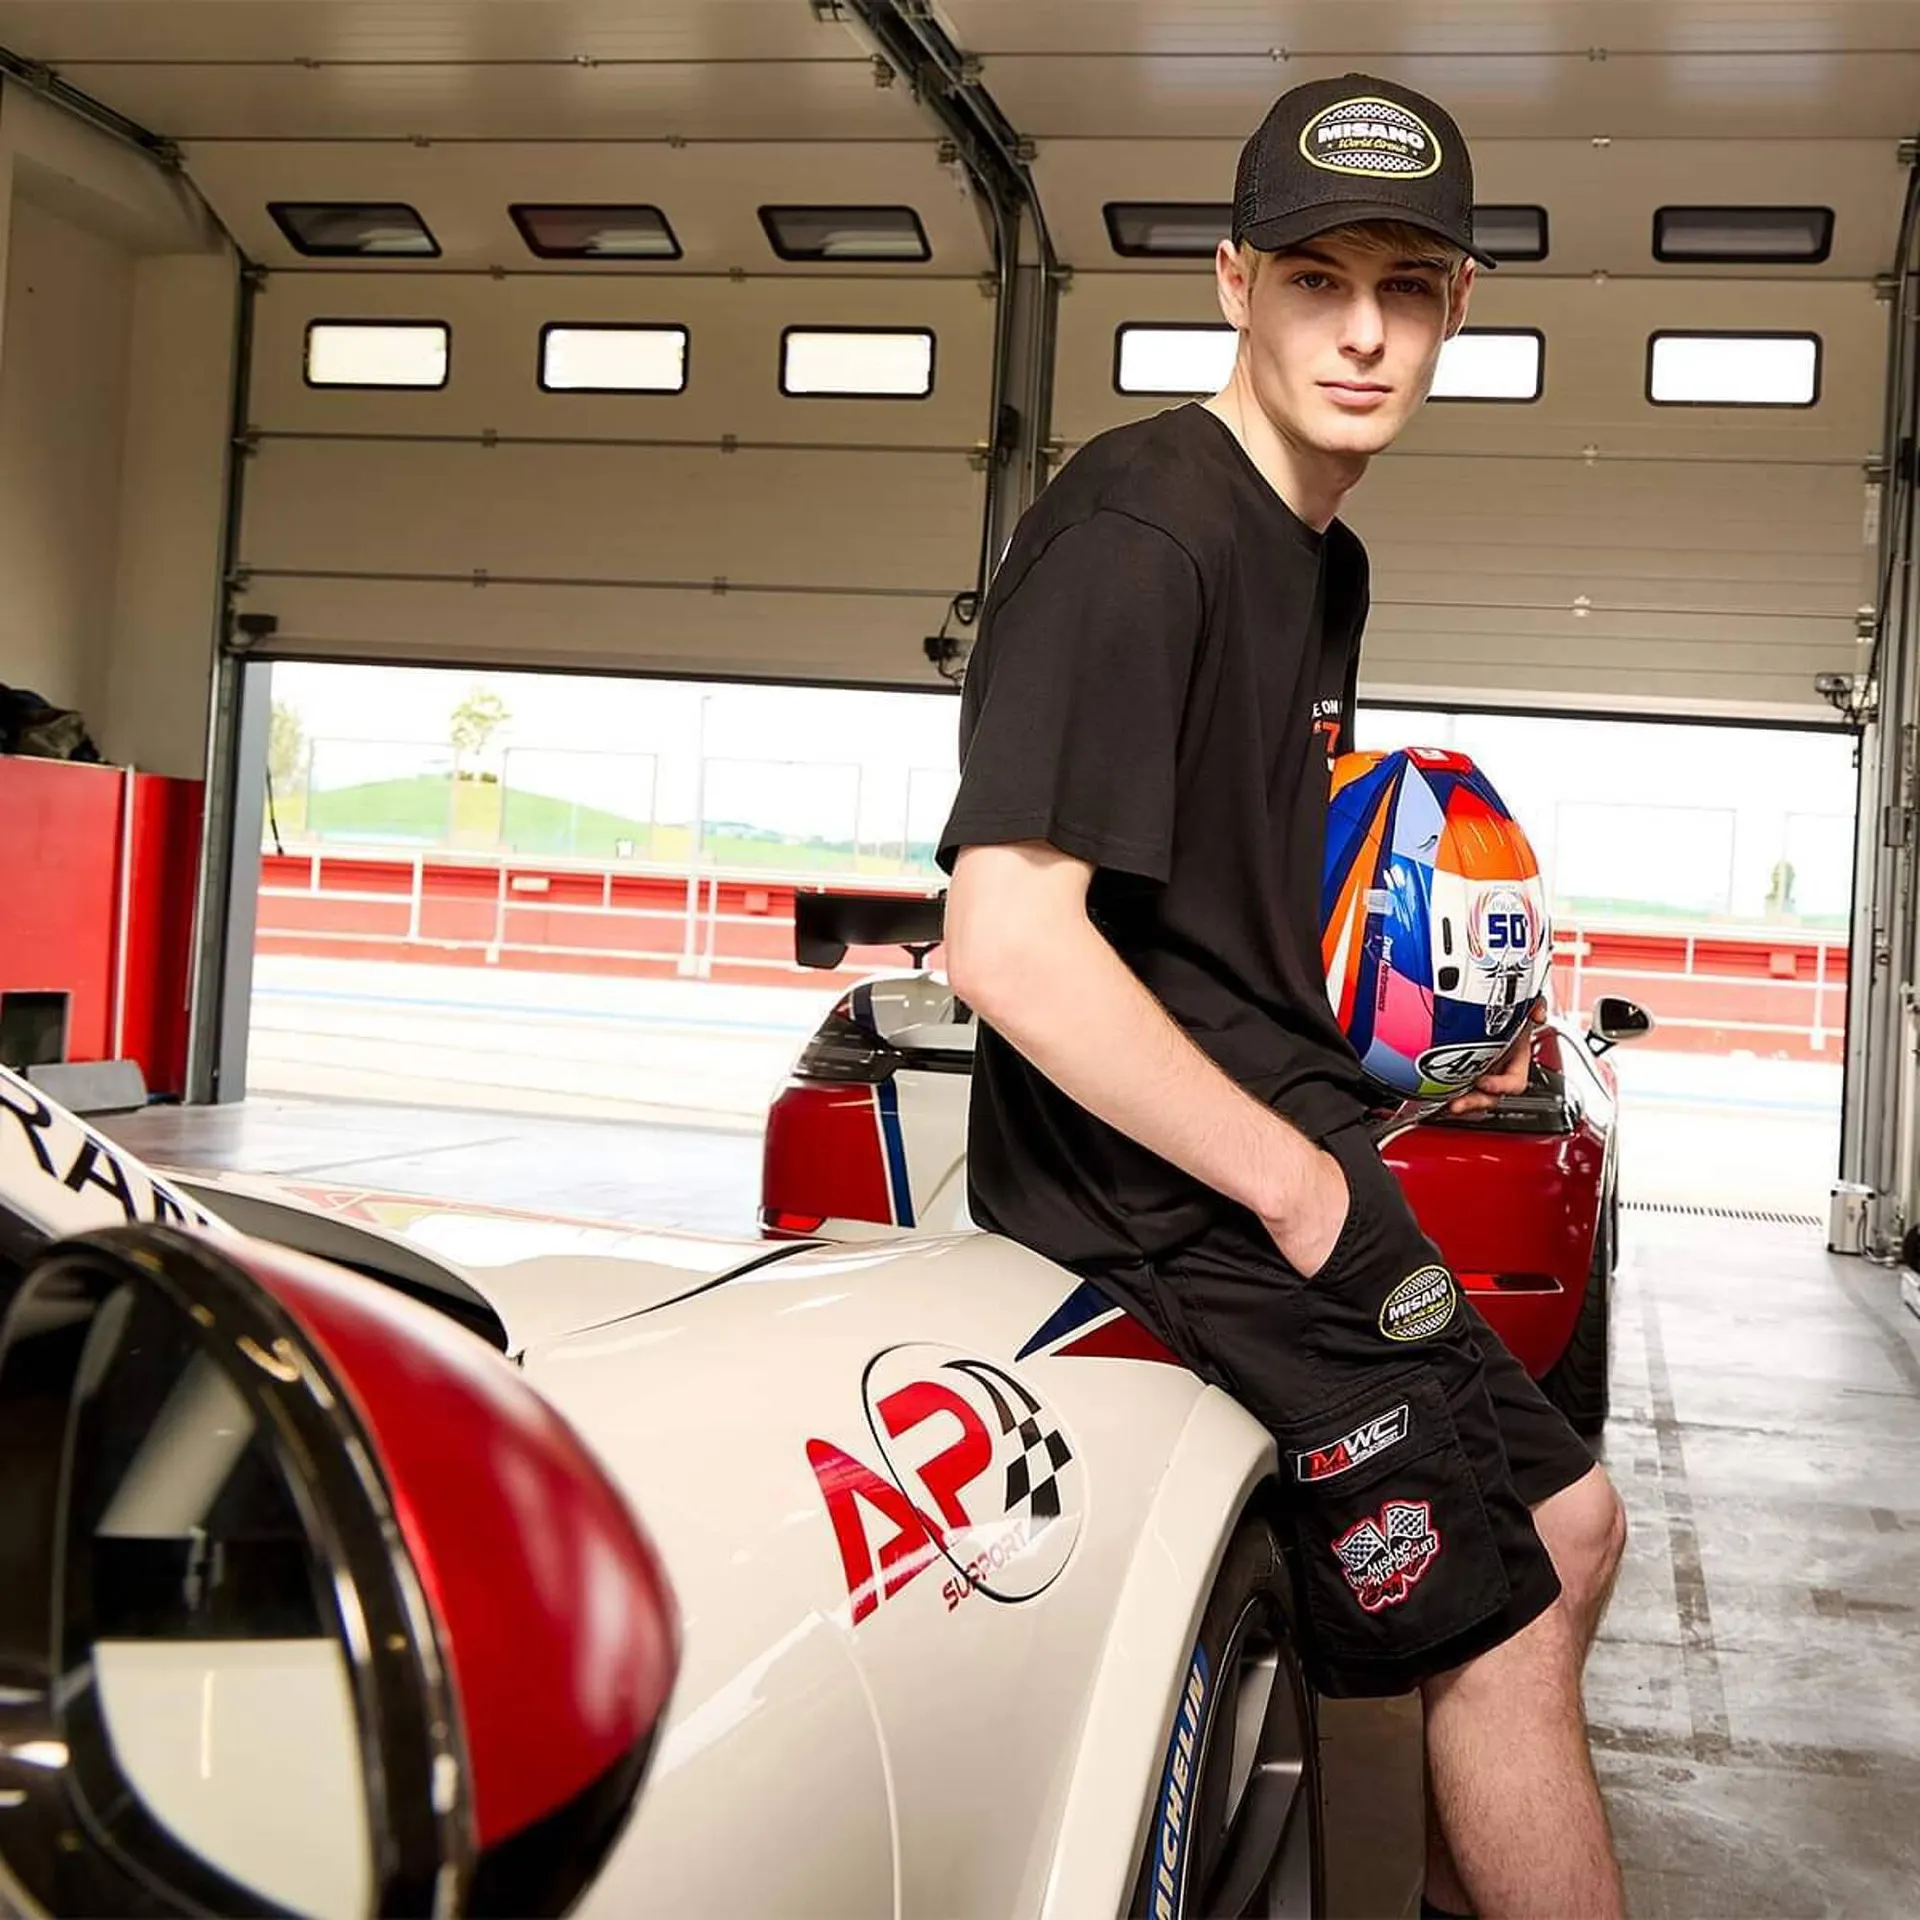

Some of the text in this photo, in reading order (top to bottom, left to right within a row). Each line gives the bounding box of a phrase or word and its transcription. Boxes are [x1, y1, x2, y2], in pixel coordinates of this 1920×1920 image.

[1318, 122, 1425, 150] MISANO
[1488, 913, 1527, 948] 50
[1389, 1279, 1448, 1321] MISANO
[1308, 1410, 1400, 1477] MWC
[806, 1381, 993, 1626] AP
[942, 1521, 1030, 1613] SUPPORT
[1367, 1540, 1412, 1575] MISANO
